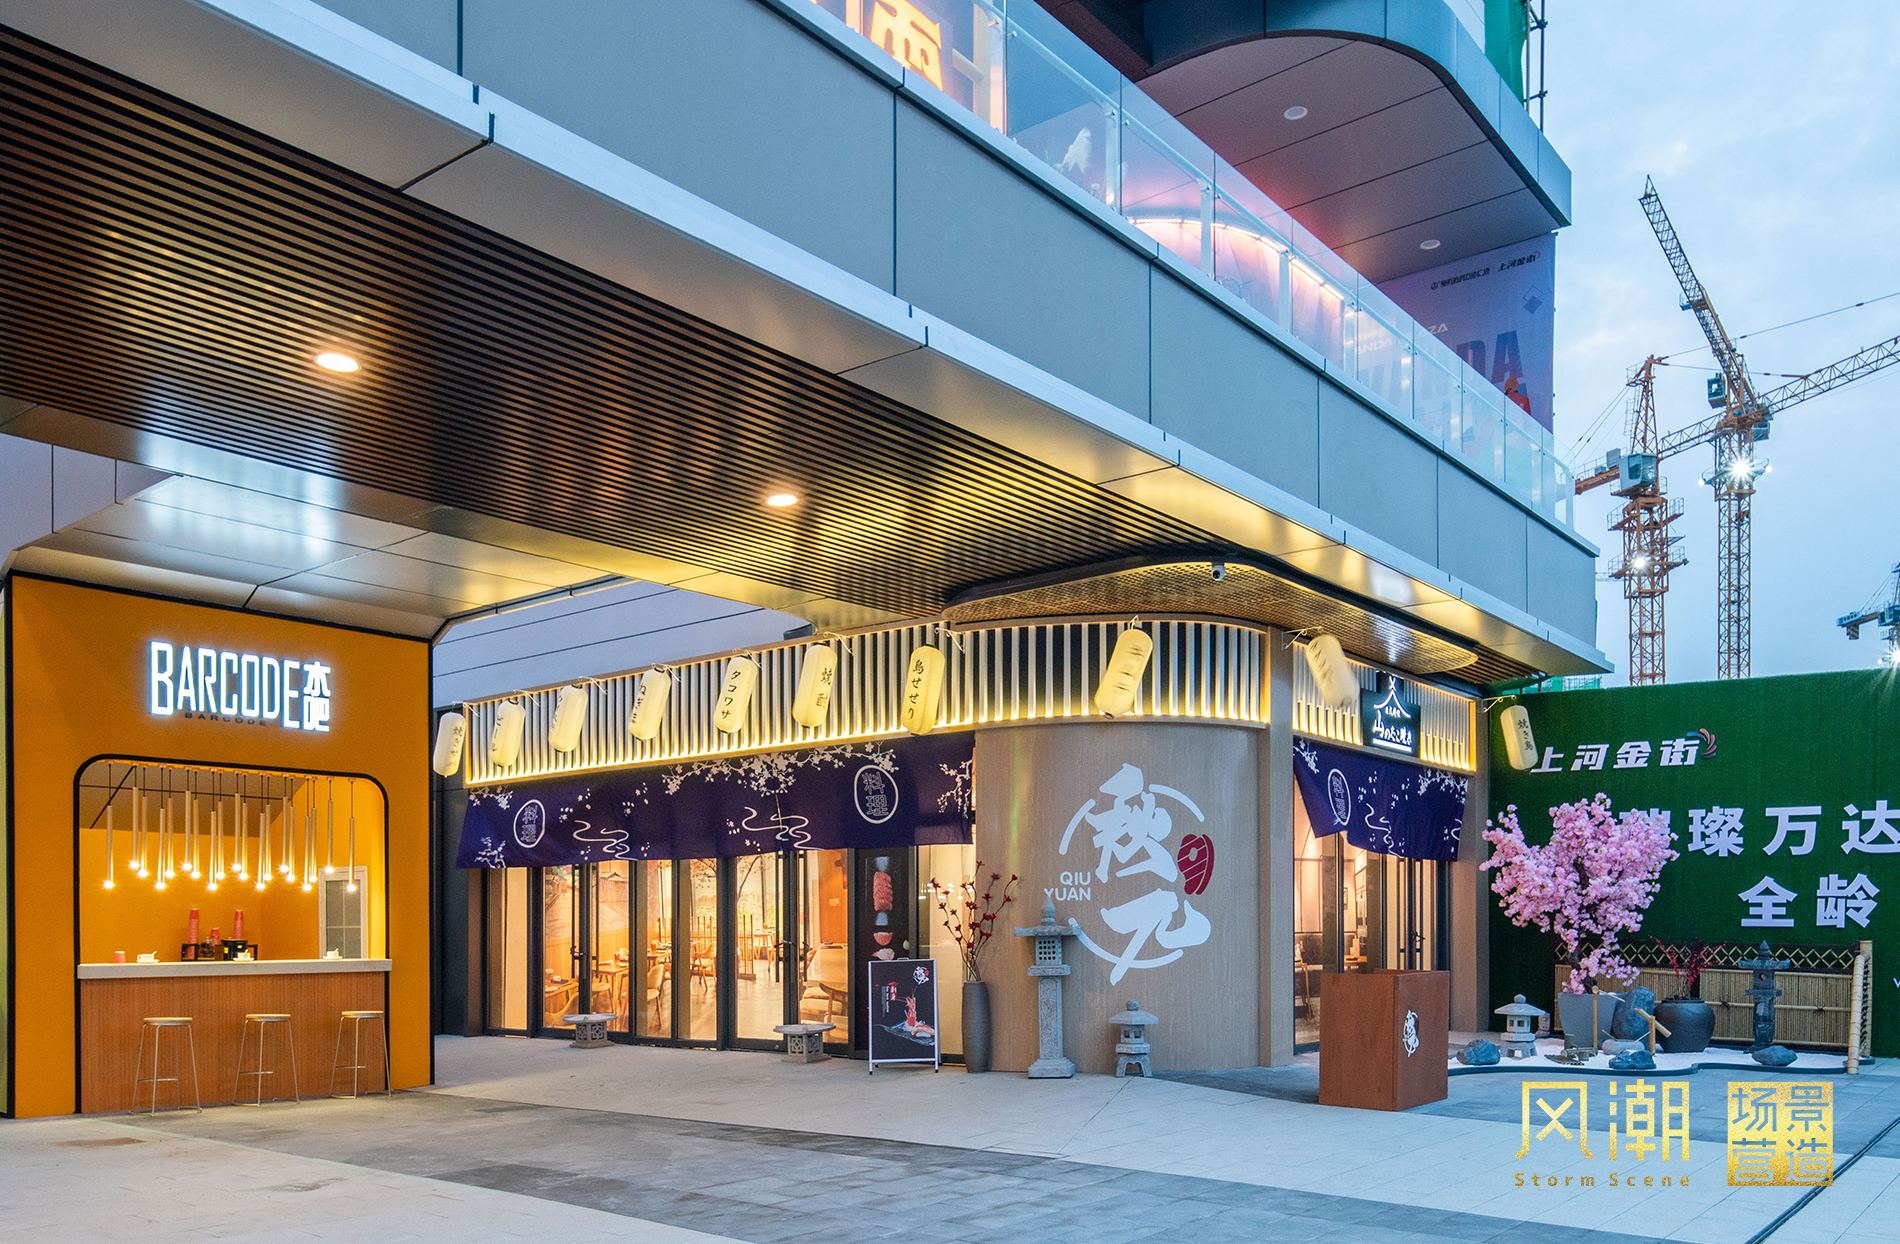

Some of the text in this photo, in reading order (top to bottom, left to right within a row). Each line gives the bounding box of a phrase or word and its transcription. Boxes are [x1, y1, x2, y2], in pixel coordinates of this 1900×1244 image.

[150, 641, 300, 729] BARCODE
[720, 670, 741, 720] タコワサ
[184, 711, 267, 726] BARCODE
[1530, 738, 1700, 774] 上河金街
[862, 772, 889, 816] 料理
[1044, 887, 1091, 901] YUAN
[1060, 871, 1091, 886] QIU
[1738, 873, 1880, 929] 全龄
